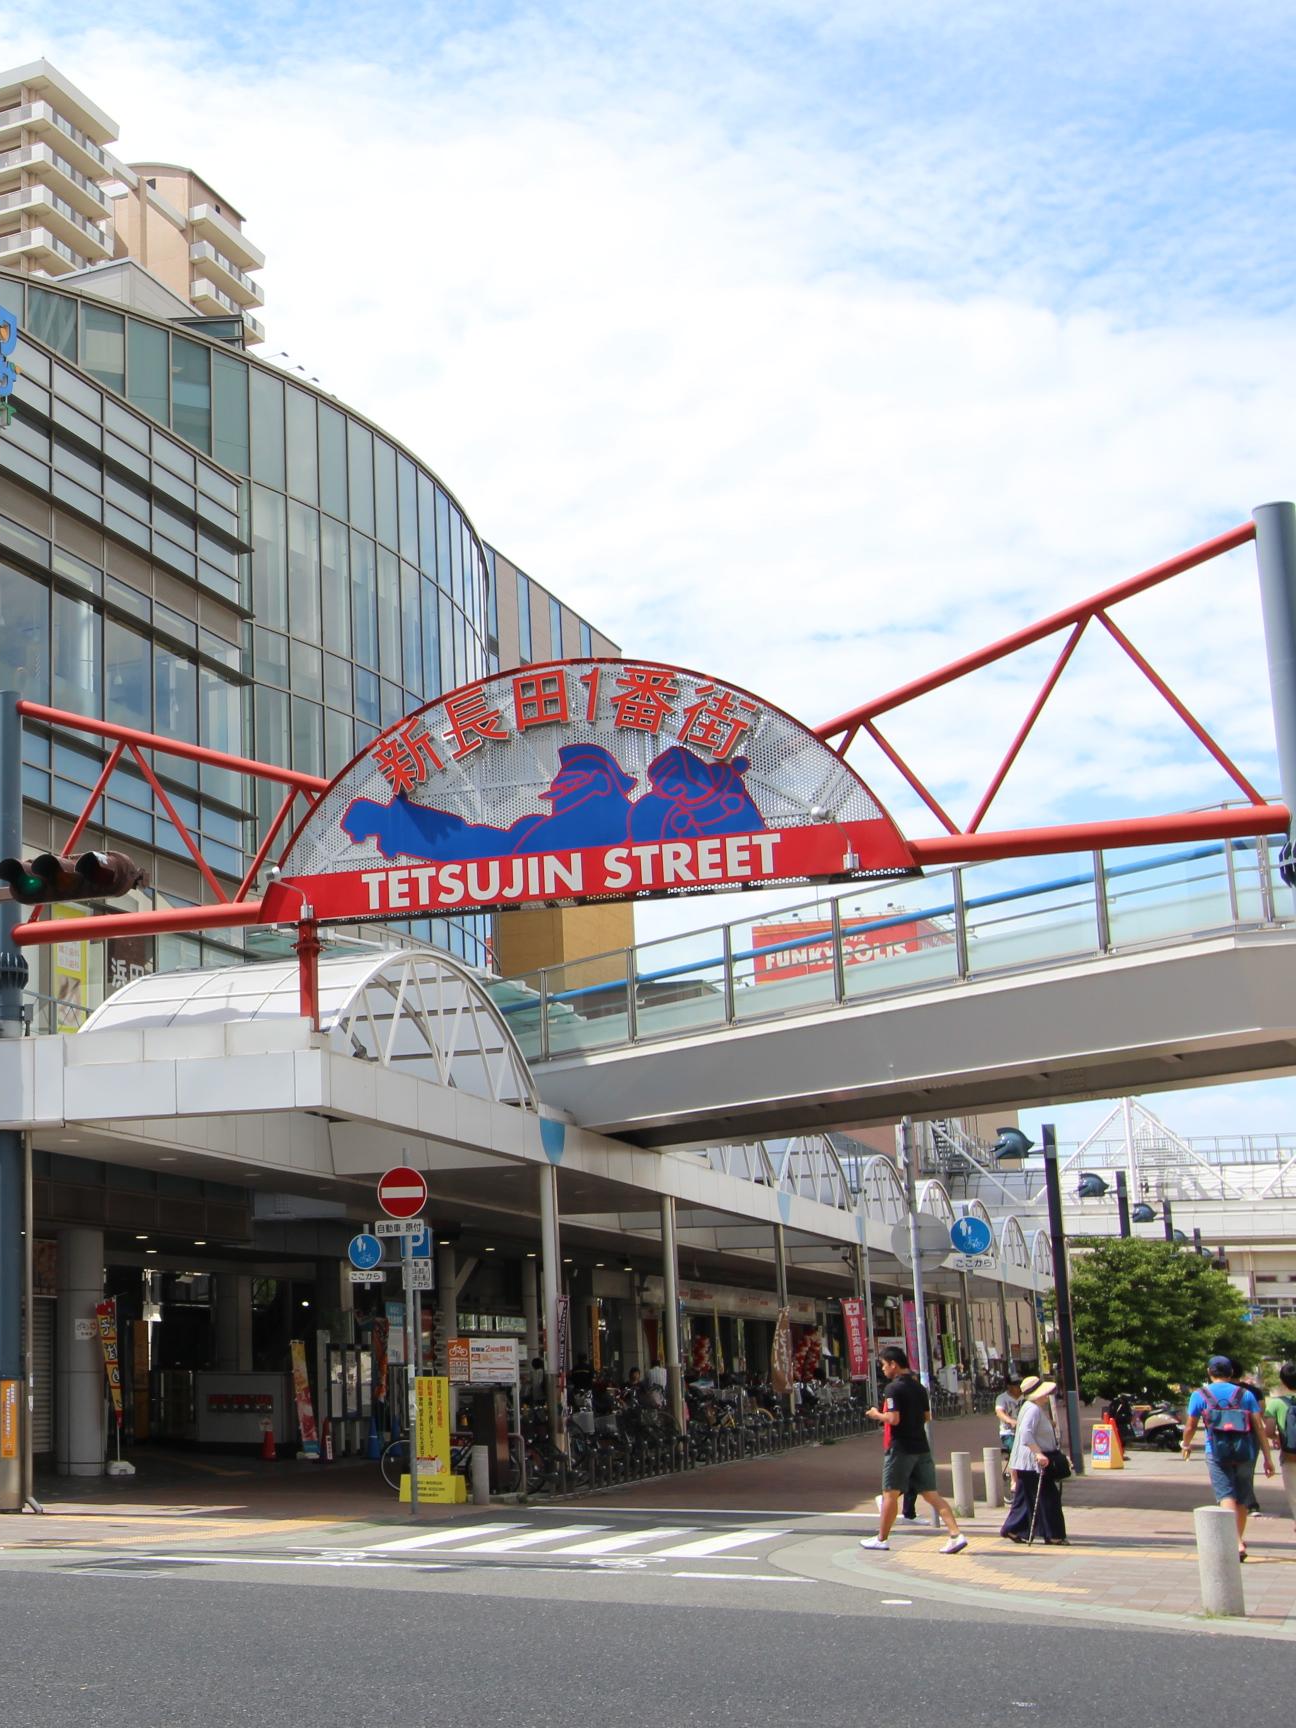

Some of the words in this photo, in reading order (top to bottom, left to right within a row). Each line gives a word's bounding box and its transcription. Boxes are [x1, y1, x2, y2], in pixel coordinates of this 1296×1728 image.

[371, 667, 758, 794] 新長田1番街
[361, 852, 584, 911] TETSUJIN
[603, 833, 782, 889] STREET
[351, 1272, 380, 1280] ここから
[956, 1259, 992, 1268] ここから
